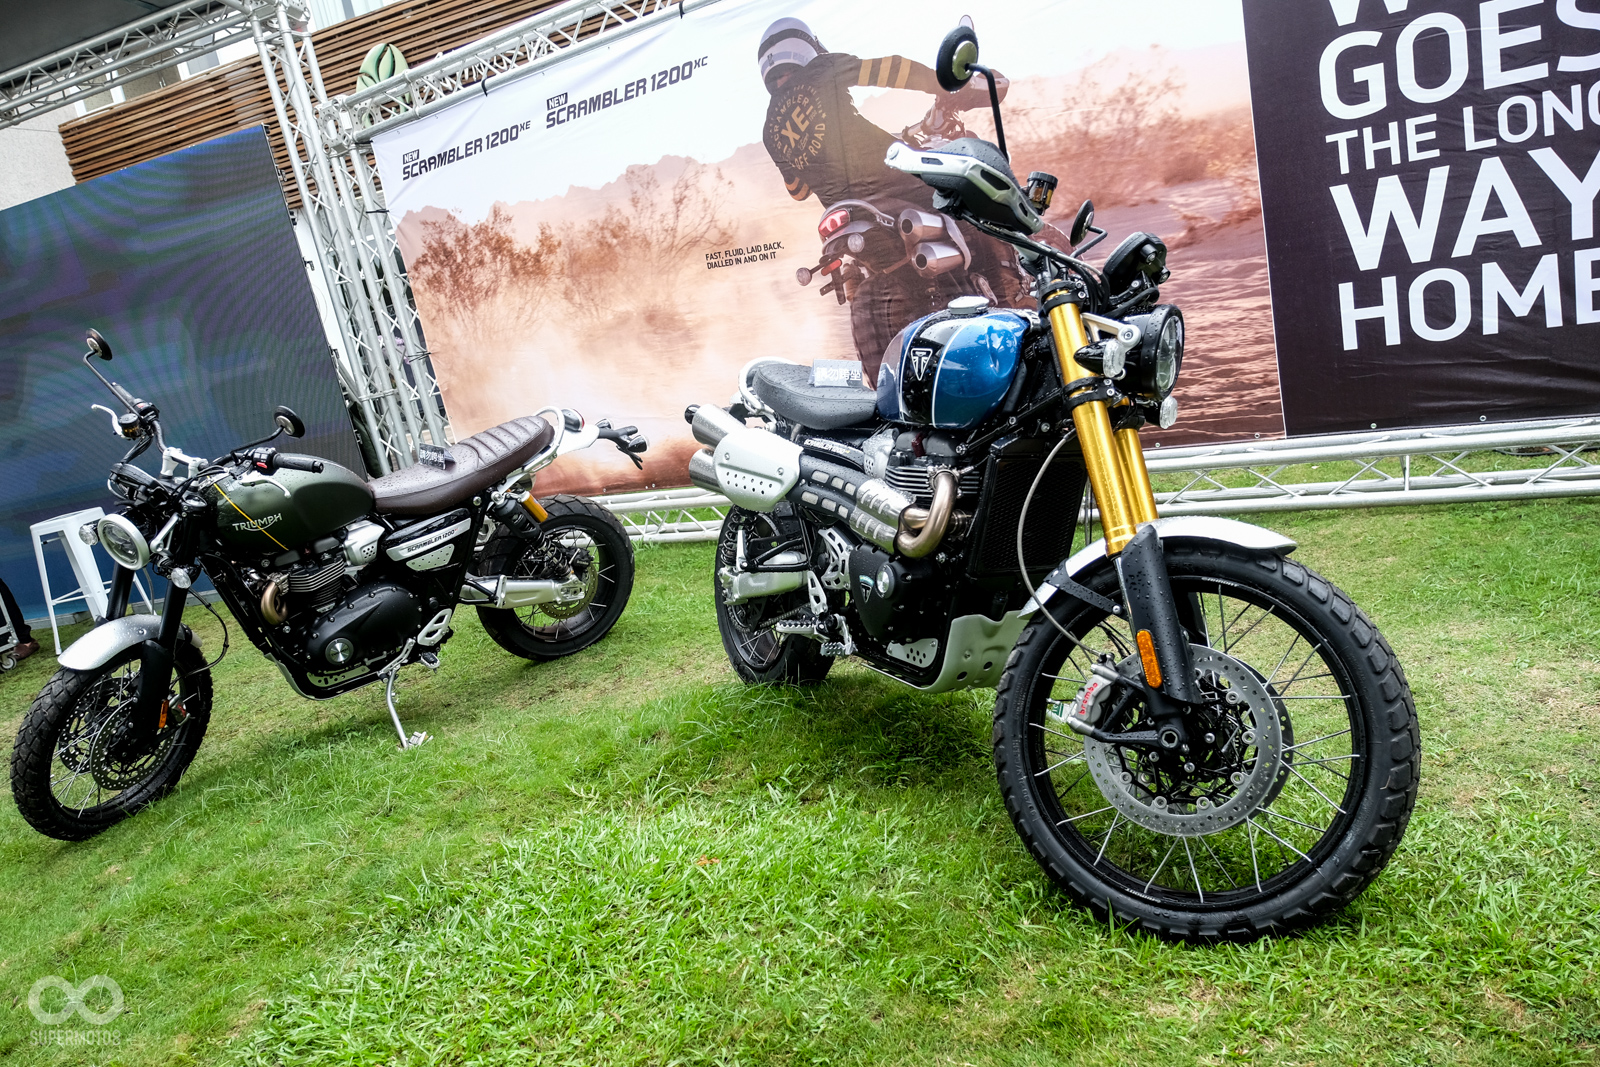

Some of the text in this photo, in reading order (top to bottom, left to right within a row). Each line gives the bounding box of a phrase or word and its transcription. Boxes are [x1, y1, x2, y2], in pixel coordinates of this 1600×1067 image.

[1318, 0, 1600, 120] GOES
[546, 77, 647, 129] SCRAMBLER
[548, 92, 568, 110] NEW
[402, 137, 483, 181] SCRAMBLER
[403, 149, 420, 164] NEW
[794, 152, 809, 170] OFF
[808, 123, 826, 156] ROAD
[1325, 112, 1441, 175] THE
[1329, 147, 1600, 271] WAY
[705, 241, 785, 261] FAST, FLUID, LAID BACK,
[706, 251, 777, 270] DIALLED IN AND ON IT
[232, 512, 283, 531] TRIUMPH
[407, 535, 442, 553] SCRAMBLER
[1078, 682, 1098, 715] brembo
